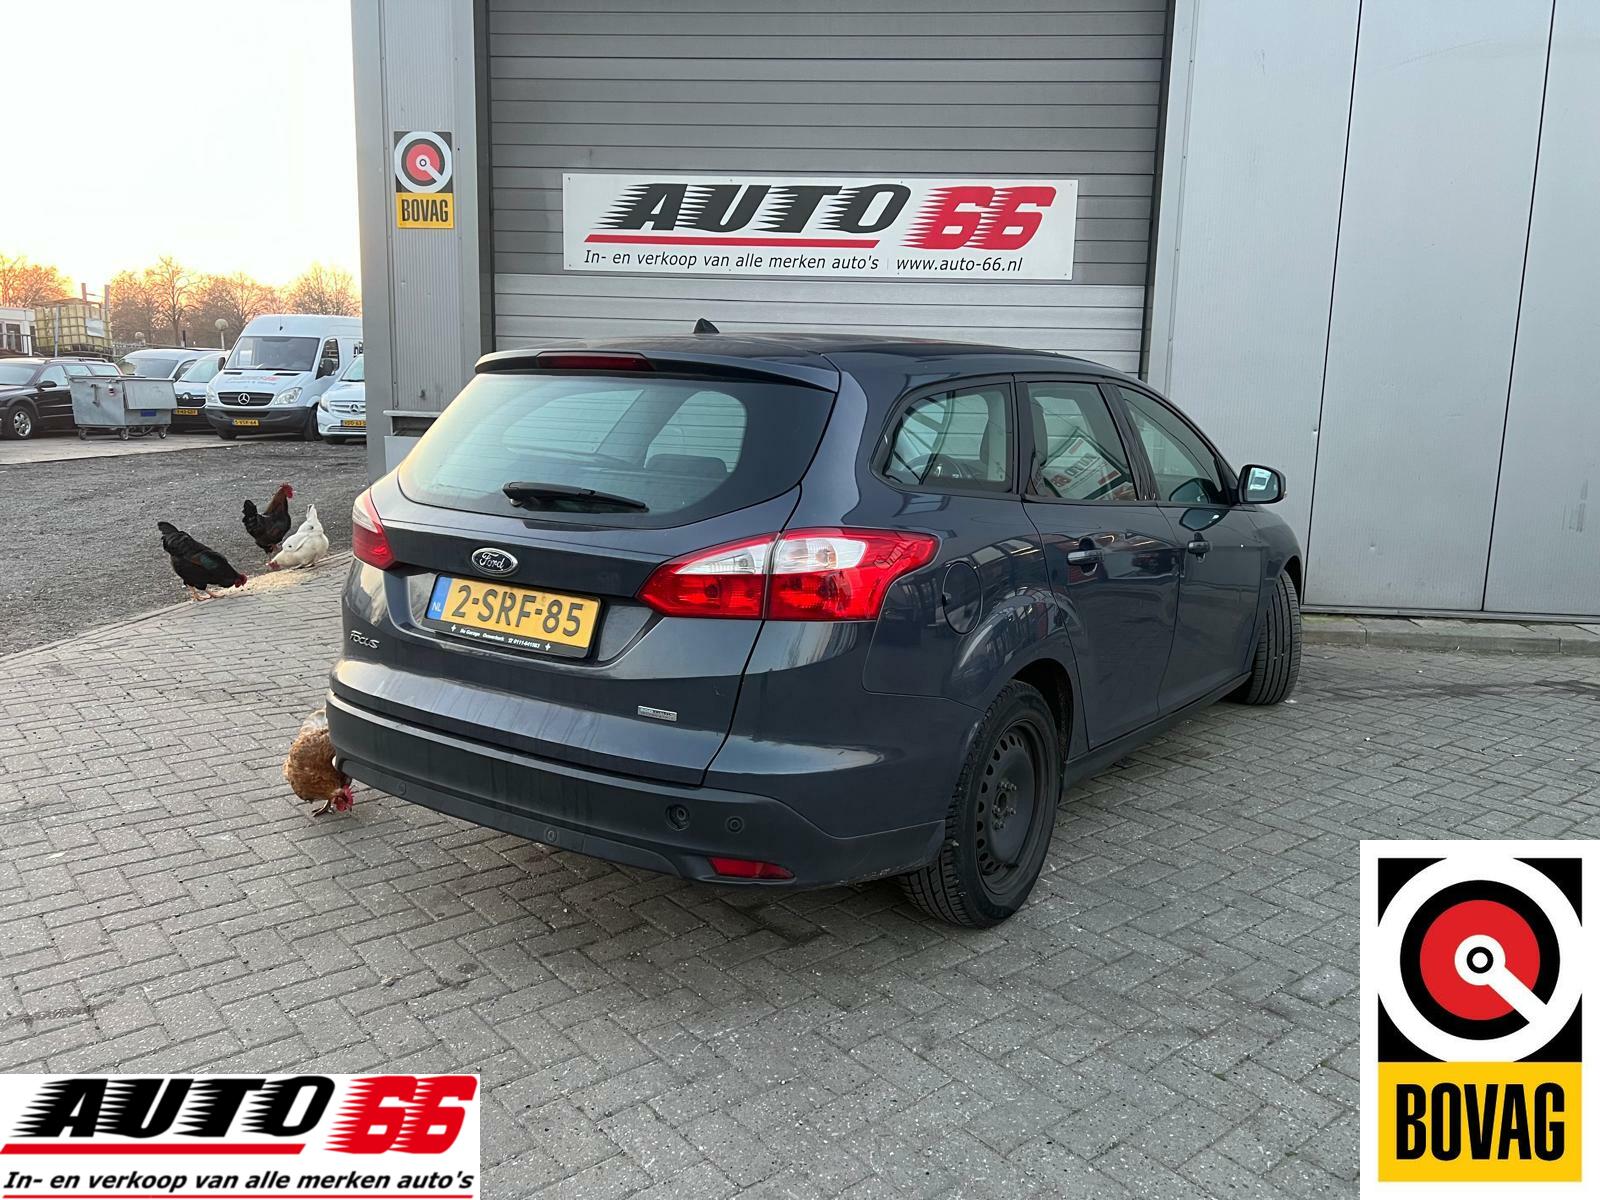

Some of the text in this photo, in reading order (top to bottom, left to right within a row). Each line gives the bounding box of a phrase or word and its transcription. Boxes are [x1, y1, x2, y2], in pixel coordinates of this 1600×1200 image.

[401, 199, 448, 222] BOVAG
[589, 183, 1057, 250] AUTO 66
[584, 250, 1023, 272] In- en verkoop van alle merken auto's www.auto-66.nl
[479, 552, 505, 571] Ford
[431, 584, 584, 637] NL 2-SRF-85
